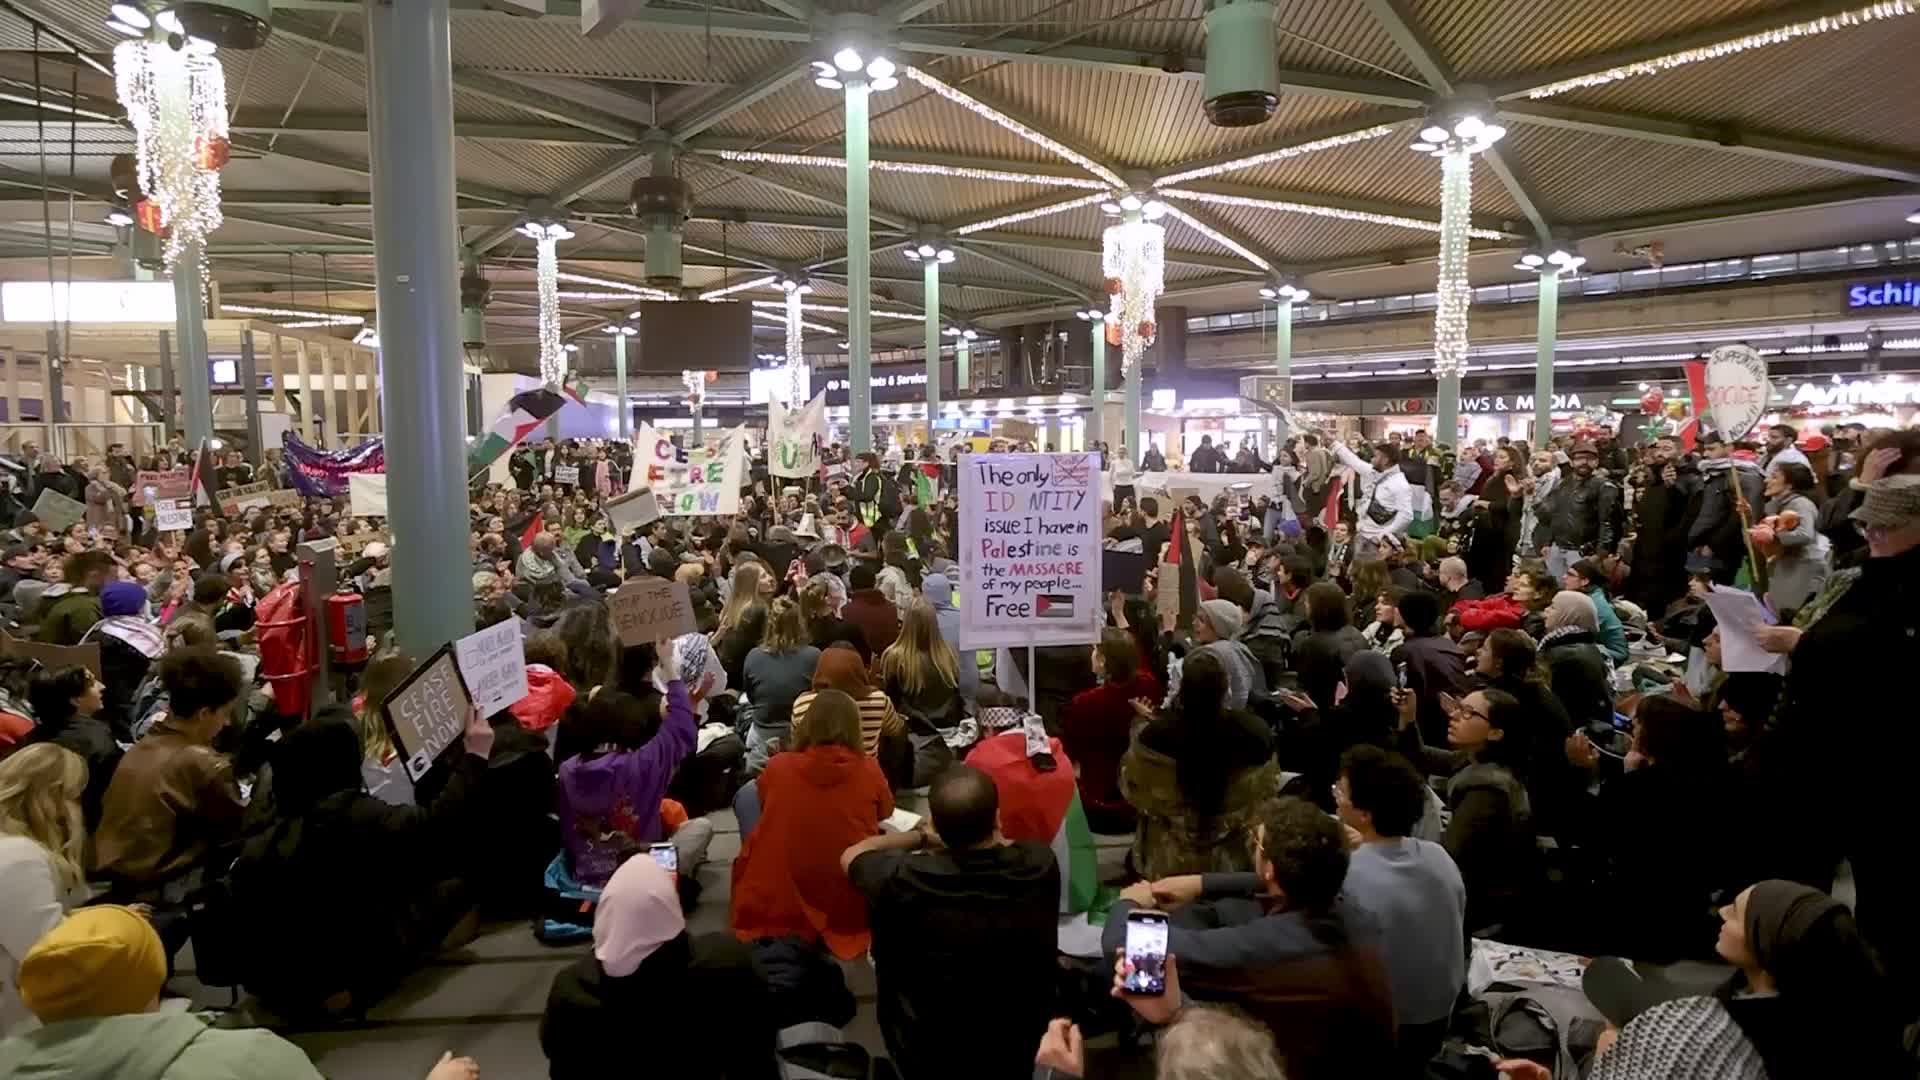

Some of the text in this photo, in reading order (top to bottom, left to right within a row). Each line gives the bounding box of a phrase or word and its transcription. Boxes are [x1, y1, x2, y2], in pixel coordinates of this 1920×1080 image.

[1495, 396, 1508, 411] &
[1516, 393, 1581, 411] MDIA
[976, 461, 1013, 486] The
[1017, 463, 1050, 488] only
[655, 491, 721, 514] NOW
[985, 516, 1088, 535] issue I have in
[981, 538, 1079, 558] Palestine is
[981, 561, 1083, 576] the MASSACRE
[647, 587, 672, 600] THE
[982, 578, 998, 590] of
[1000, 581, 1021, 594] my
[986, 594, 1030, 617] Free
[401, 664, 449, 717] CEASE
[412, 689, 455, 737] FIRE
[424, 711, 460, 760] NOW
